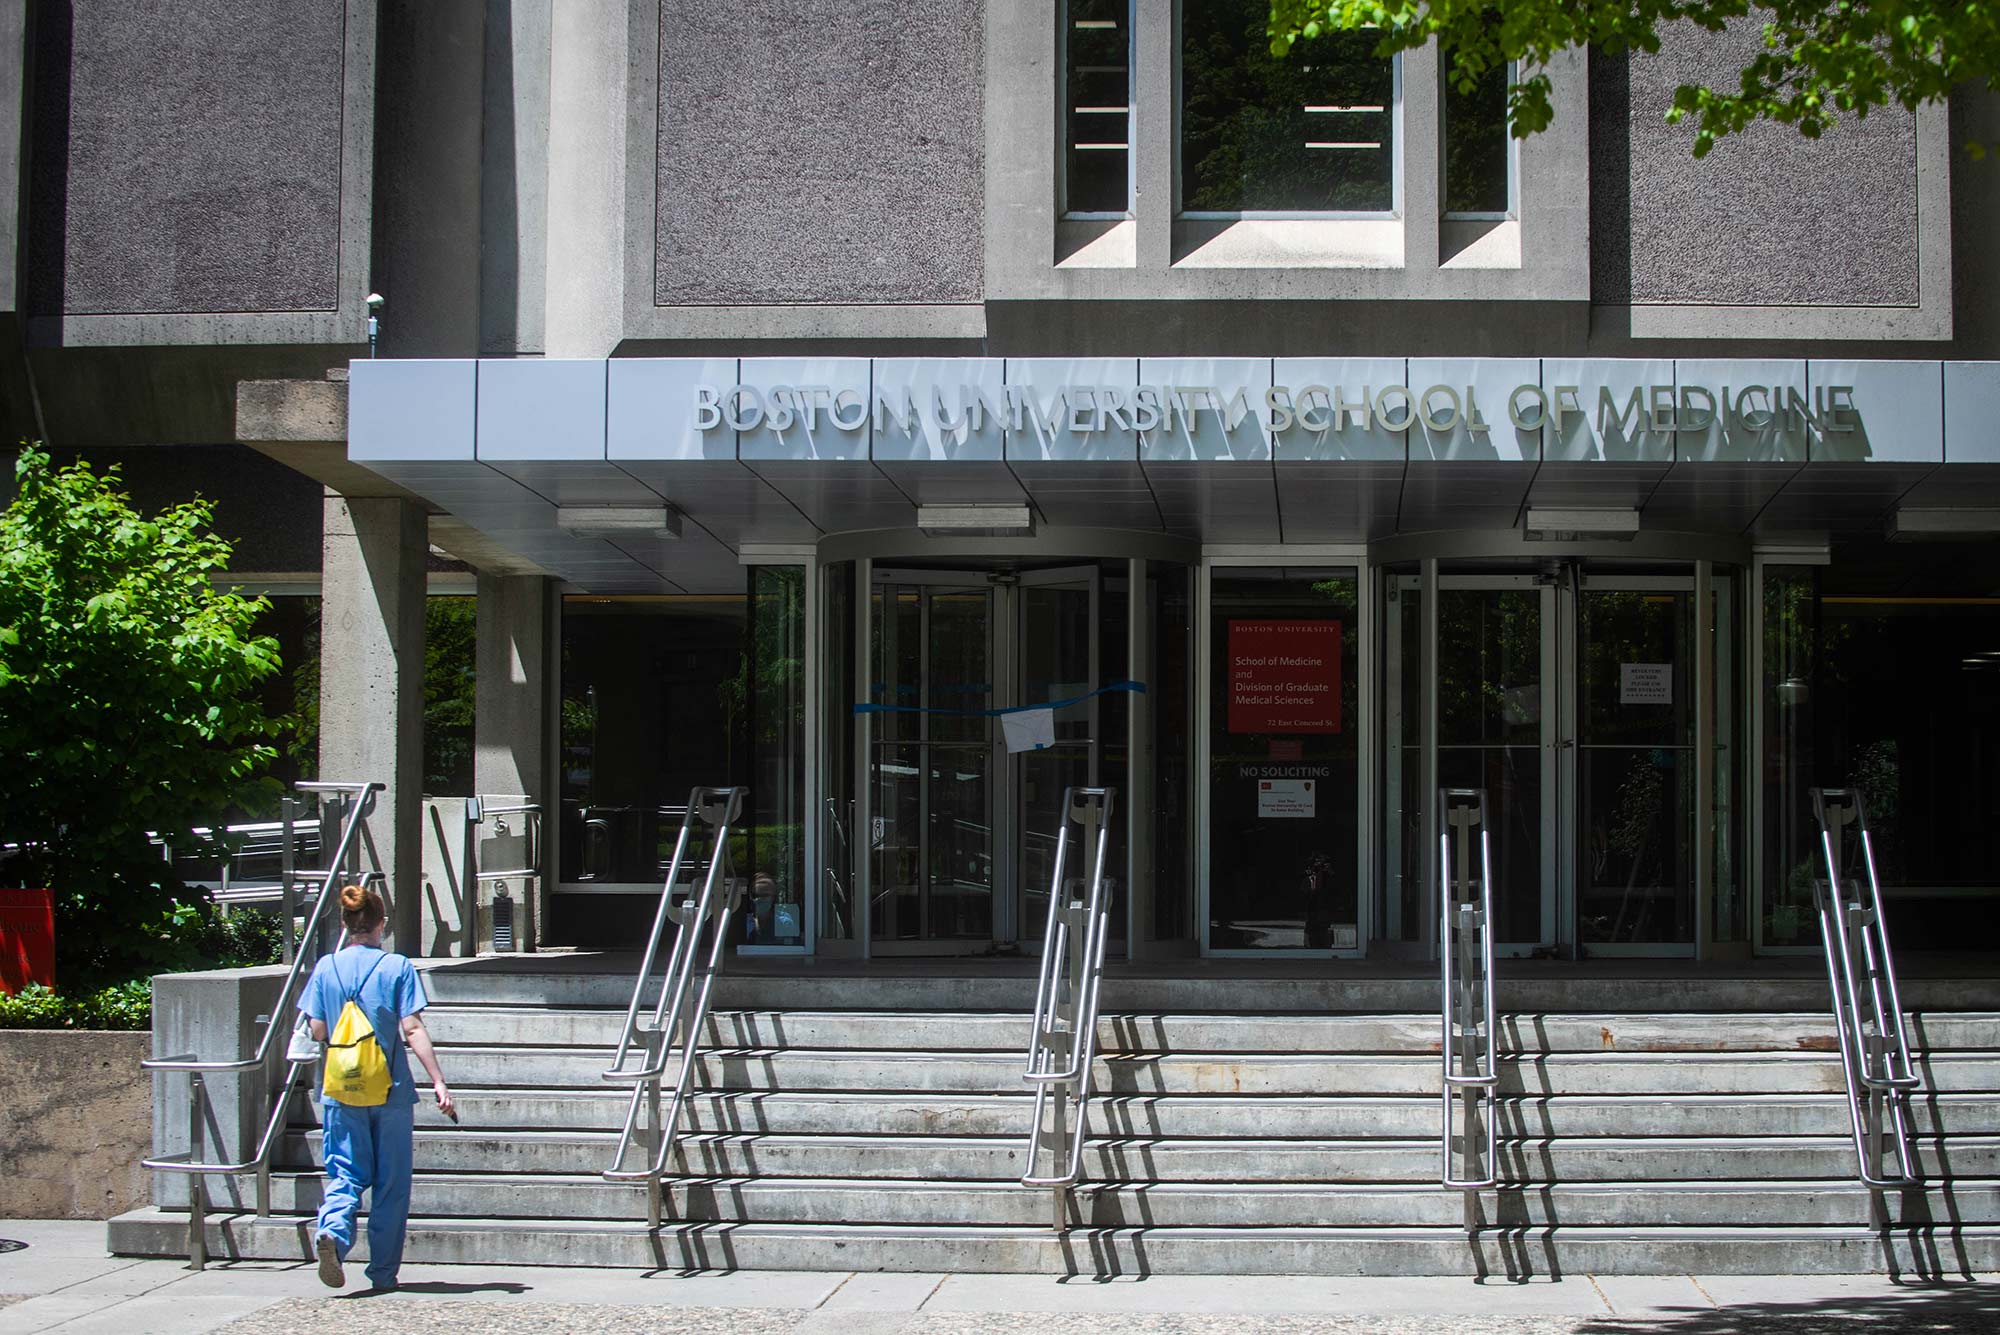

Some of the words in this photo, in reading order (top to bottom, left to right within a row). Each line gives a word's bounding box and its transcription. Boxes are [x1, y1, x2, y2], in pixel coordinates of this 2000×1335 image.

[691, 383, 910, 432] BOSTON
[931, 383, 1249, 432] UNIVERSITY
[1265, 384, 1491, 432] SCHOOL
[1508, 384, 1580, 432] OF
[1597, 384, 1855, 432] MEDICINE
[1235, 656, 1266, 666] School
[1268, 656, 1278, 666] of
[1280, 656, 1322, 666] Medicine
[1235, 670, 1253, 679] and
[1235, 682, 1273, 692] Division
[1274, 682, 1284, 692] of
[1286, 682, 1329, 692] Graduate
[1235, 695, 1273, 705] Medical
[1274, 695, 1315, 705] Sciences
[1267, 719, 1277, 727] 72
[1240, 767, 1258, 777] NO
[1261, 767, 1330, 777] SOLICITING
